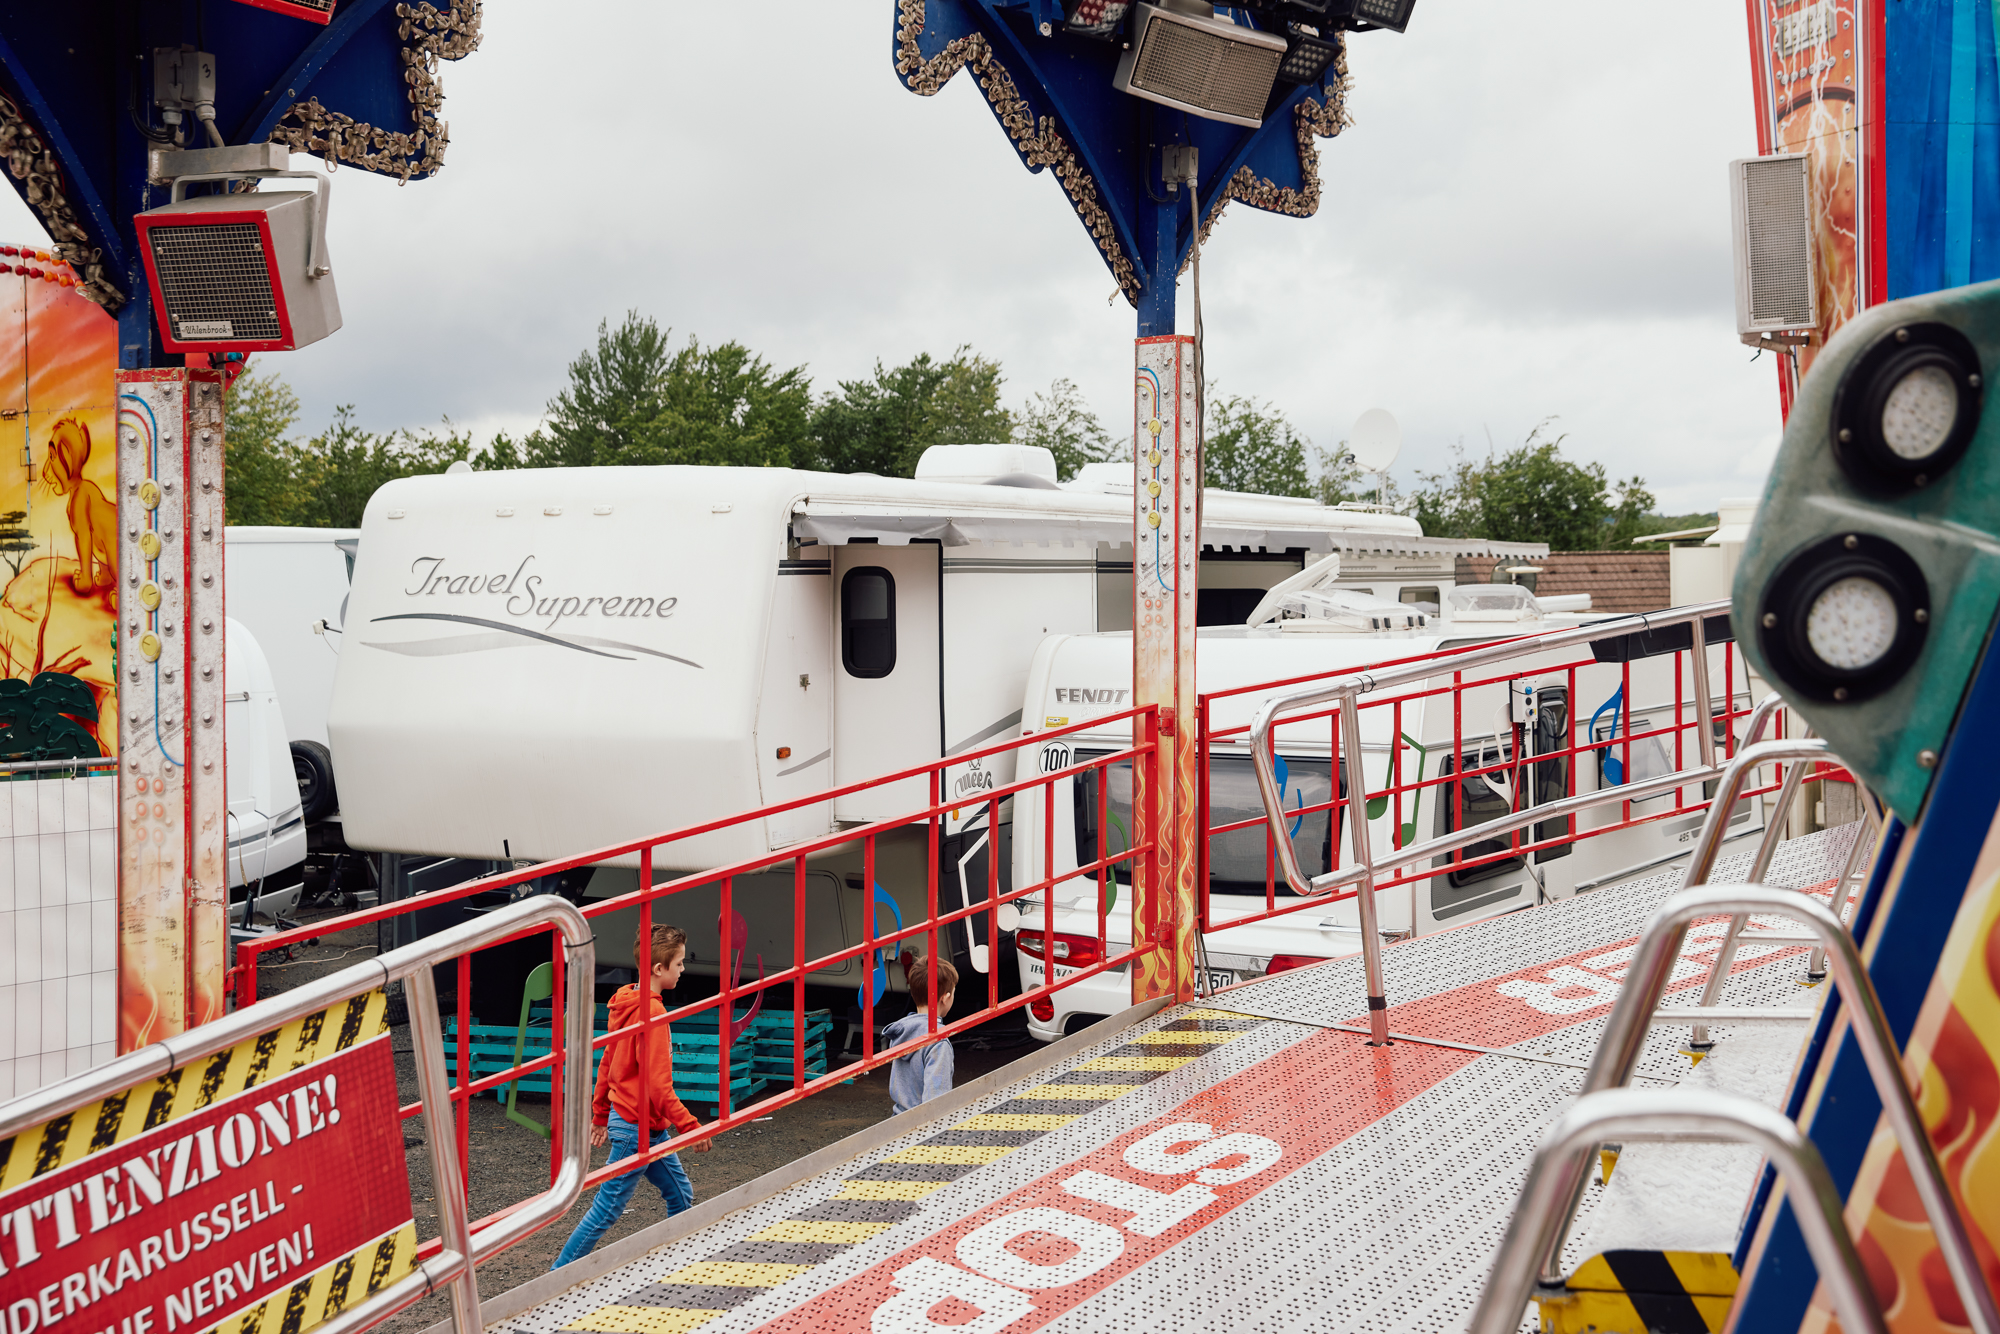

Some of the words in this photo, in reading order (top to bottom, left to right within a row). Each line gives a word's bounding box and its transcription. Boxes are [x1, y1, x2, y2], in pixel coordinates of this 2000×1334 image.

[203, 63, 211, 78] 3
[185, 325, 228, 335] Uhlenbrock
[405, 555, 536, 596] Travel
[506, 575, 678, 631] Supreme
[1055, 688, 1129, 704] FENDT
[1044, 748, 1069, 772] 100
[0, 1074, 341, 1278] TTENZIONE!
[870, 1122, 1283, 1334] STOP
[165, 1223, 315, 1333] NERVEN!
